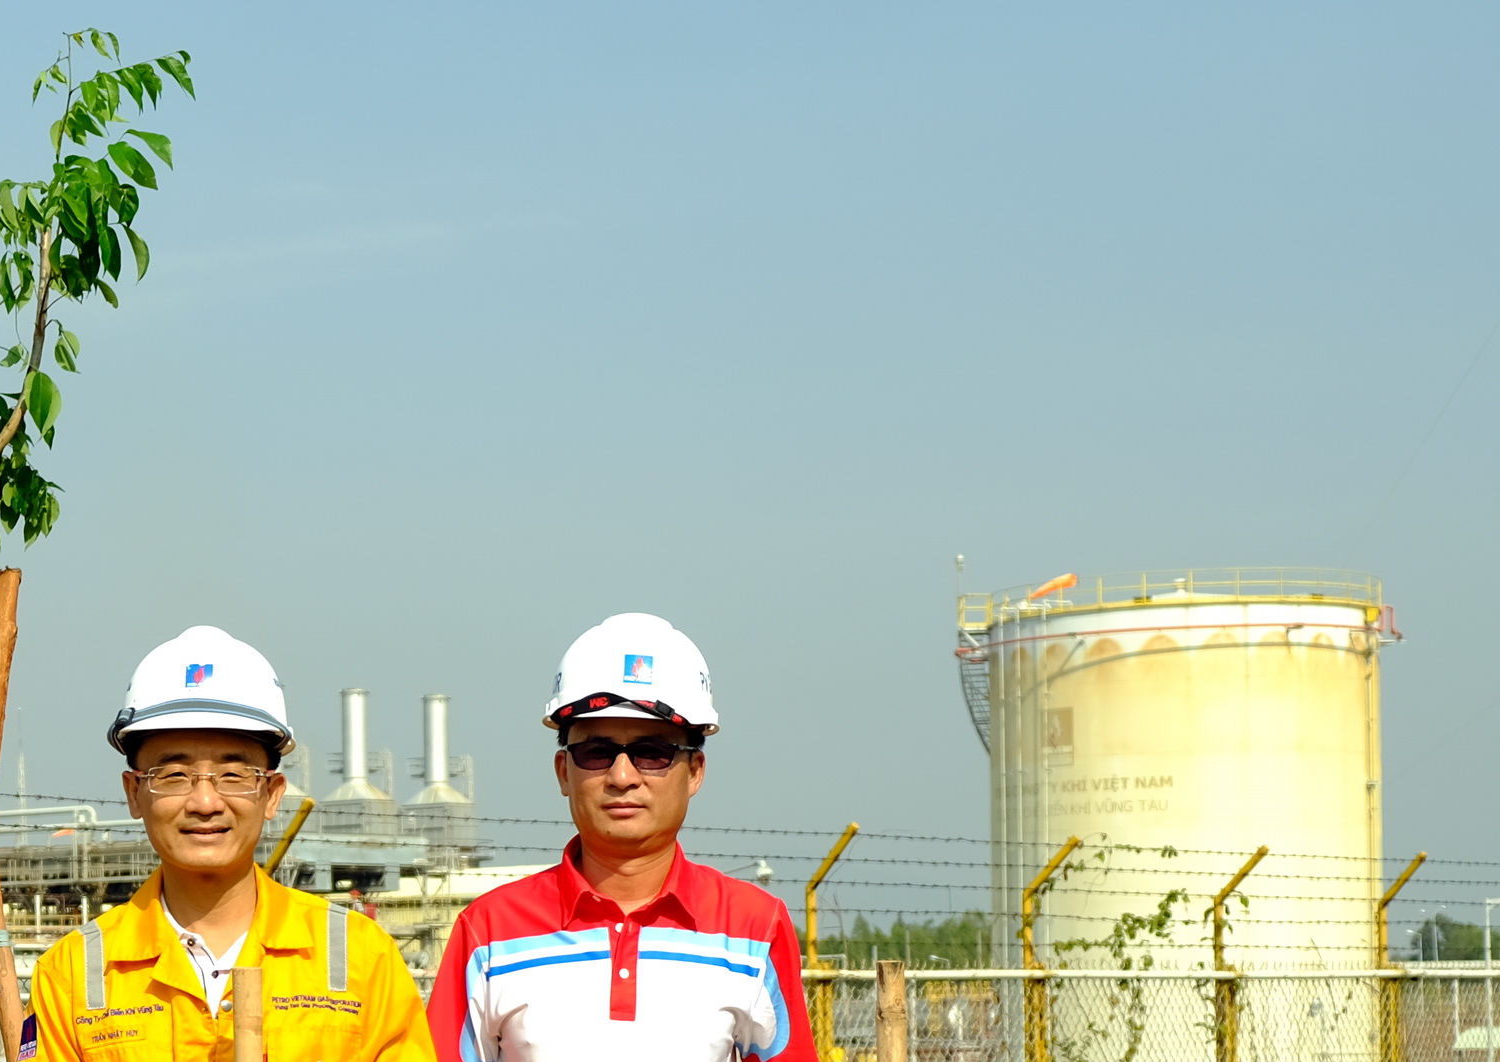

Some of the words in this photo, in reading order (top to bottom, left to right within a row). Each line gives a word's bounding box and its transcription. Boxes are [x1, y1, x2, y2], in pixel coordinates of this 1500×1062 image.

[1091, 774, 1130, 792] VIỆT
[1135, 775, 1173, 789] NAM
[1095, 797, 1134, 813] VŨNG
[271, 996, 290, 1004] PETRO
[75, 1016, 93, 1026] Công
[125, 1007, 136, 1015] Khí
[137, 1006, 153, 1015] Vũng
[126, 1029, 139, 1037] HUY
